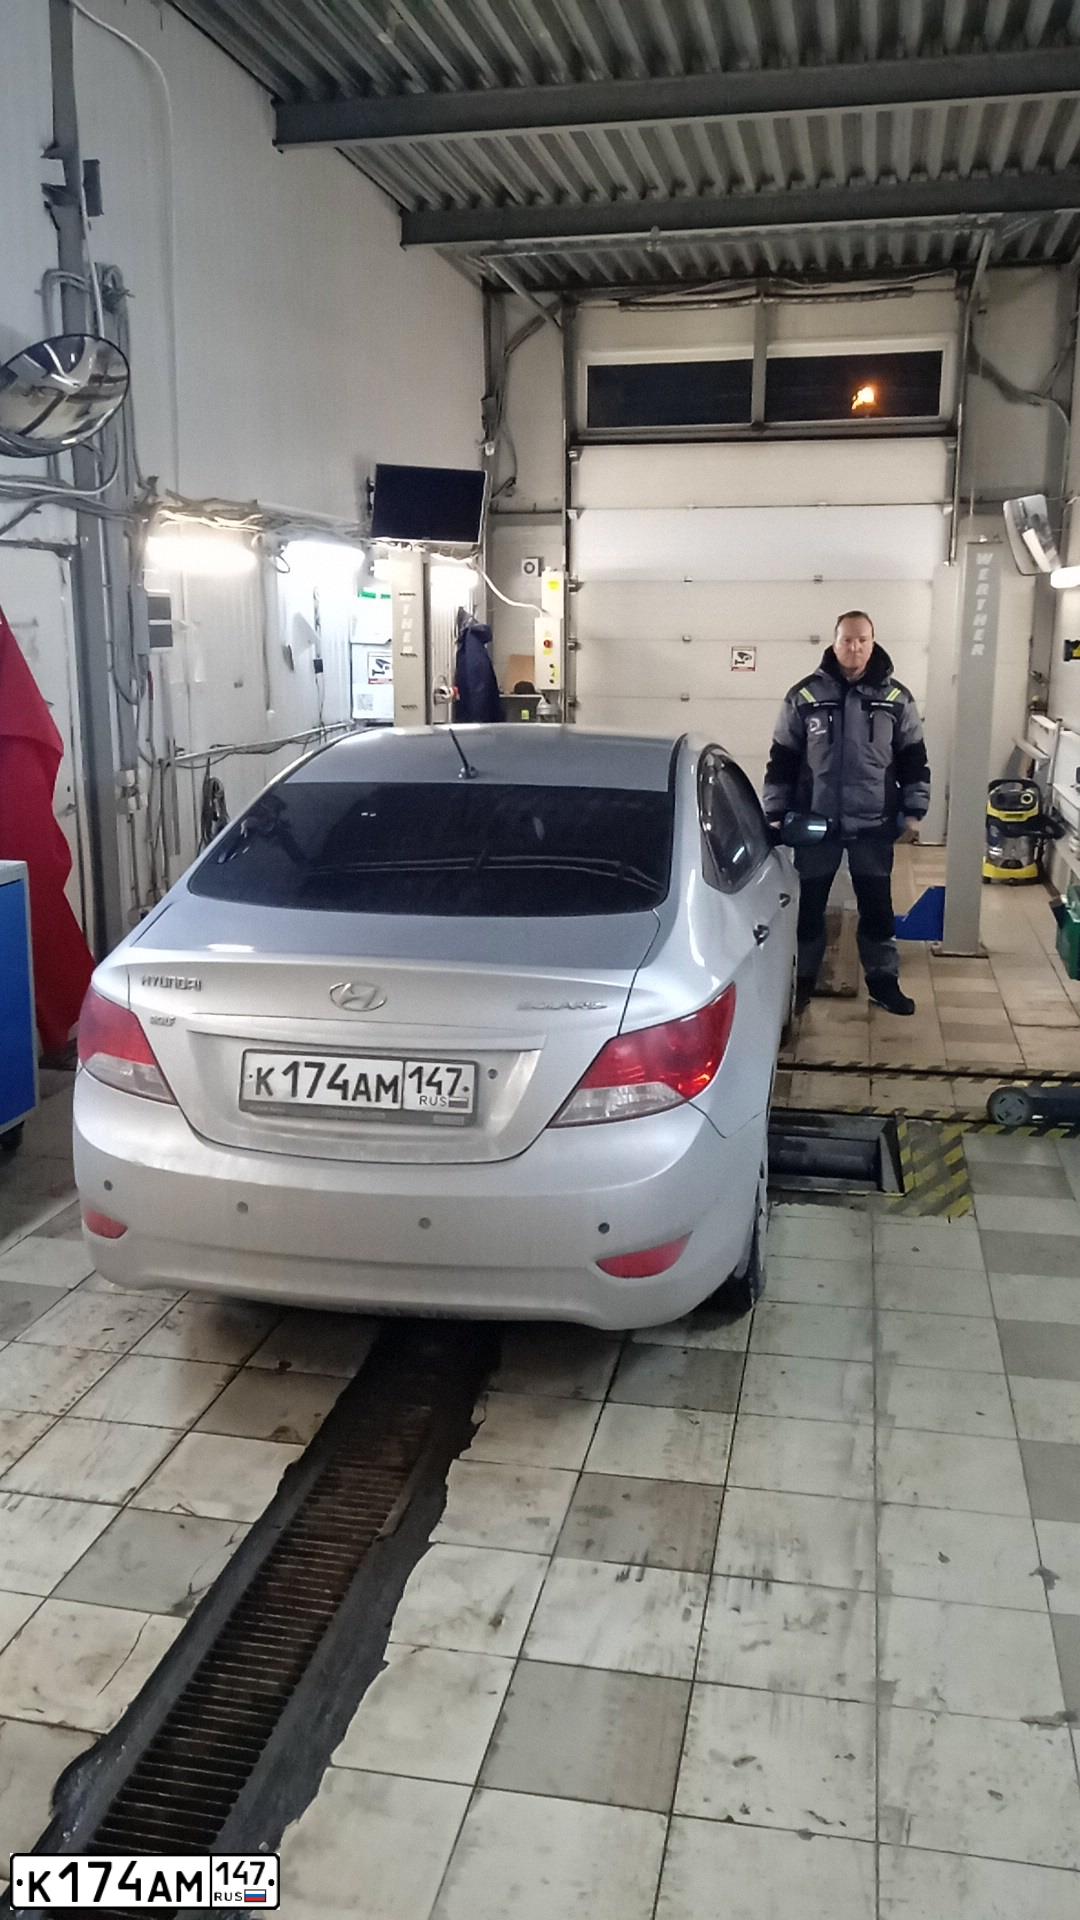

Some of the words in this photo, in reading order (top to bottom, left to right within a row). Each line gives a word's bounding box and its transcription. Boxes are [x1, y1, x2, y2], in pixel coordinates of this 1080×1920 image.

[971, 553, 993, 656] WERTHER
[141, 976, 202, 992] HYUNDAI
[255, 1060, 399, 1104] К174АМ
[408, 1066, 463, 1096] 147
[419, 1095, 448, 1107] RUS
